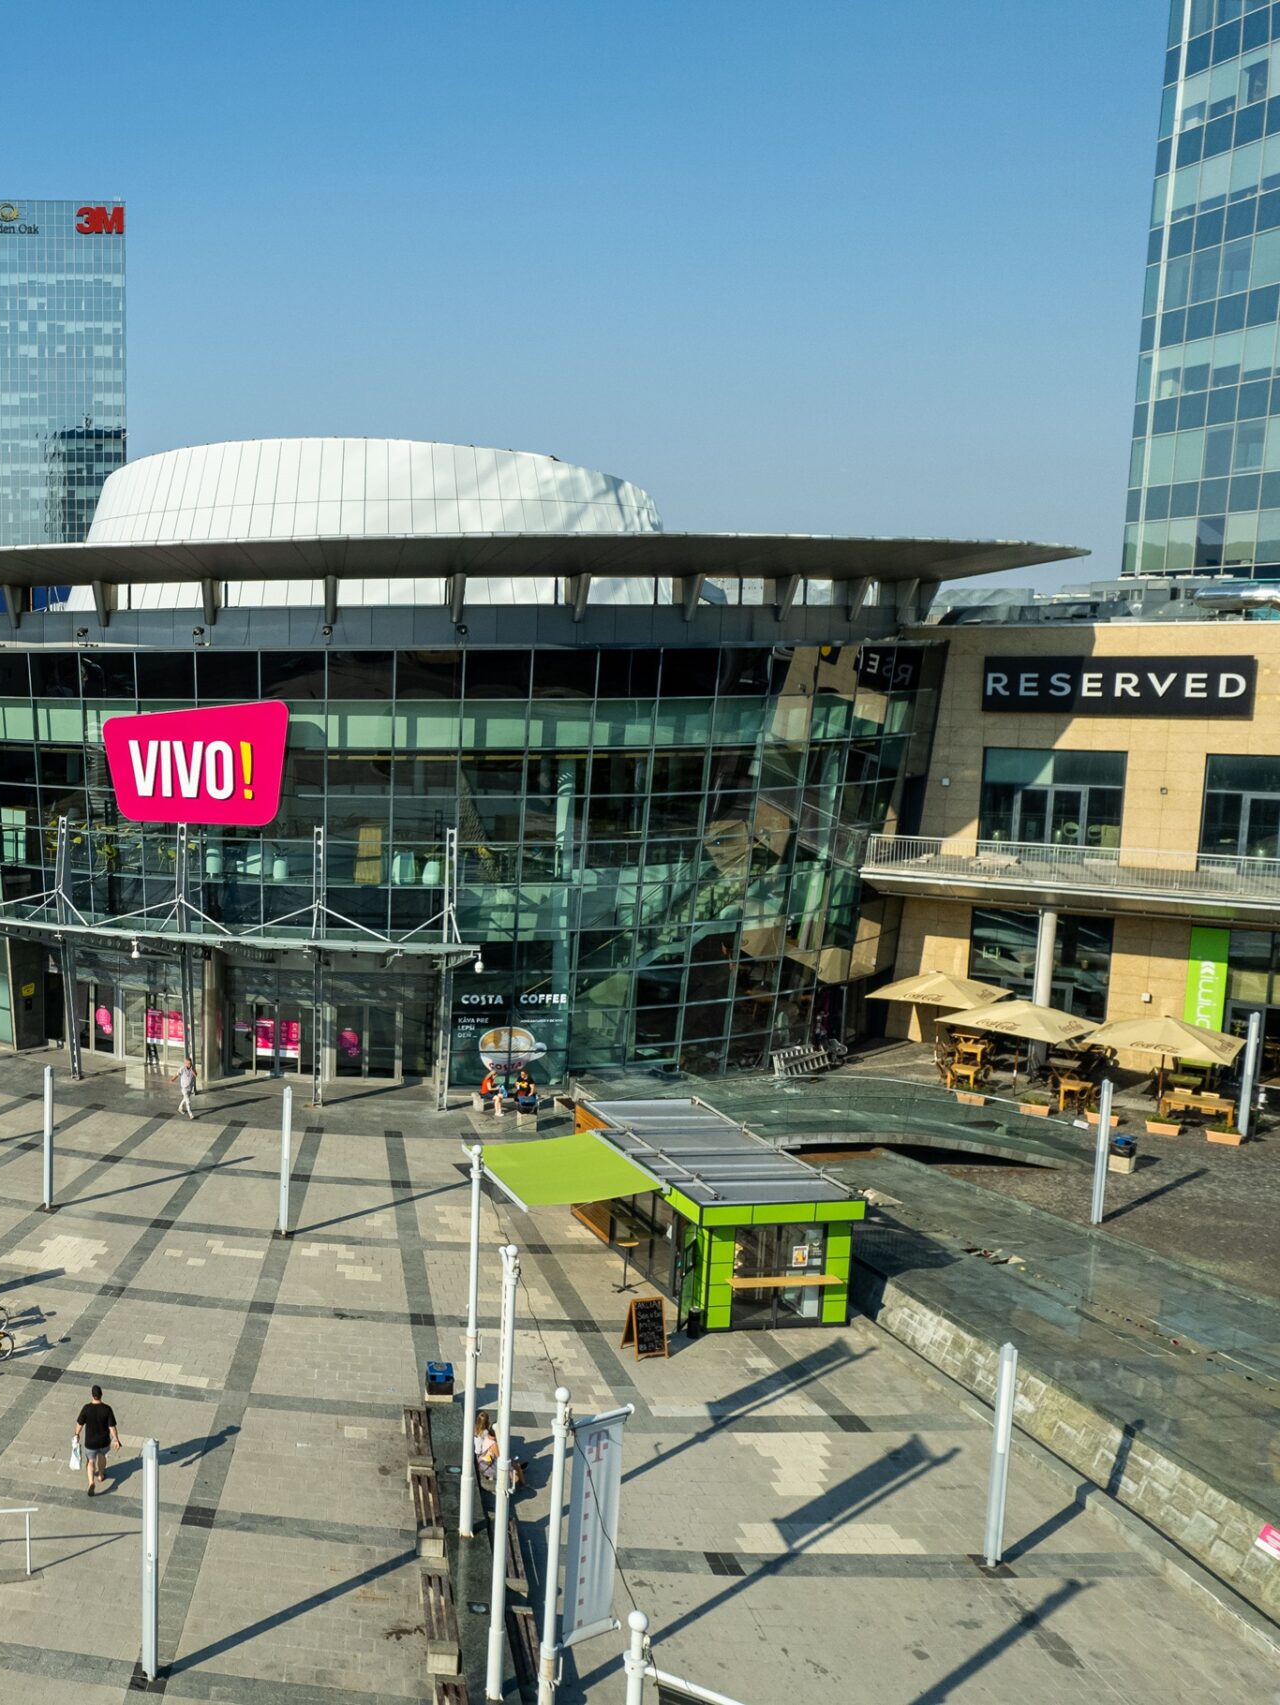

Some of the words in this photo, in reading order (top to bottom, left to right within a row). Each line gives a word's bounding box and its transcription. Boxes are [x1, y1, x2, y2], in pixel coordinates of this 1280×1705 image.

[75, 206, 125, 234] 3M
[18, 223, 39, 234] Oak
[986, 672, 1247, 698] RESERVED
[128, 740, 254, 800] VIVO!
[461, 994, 504, 1005] COSTA
[519, 993, 567, 1004] COFFEE
[903, 991, 944, 1002] Coca-Cola
[975, 1018, 1020, 1031] Coca-Cola
[1129, 1040, 1180, 1054] Coca-Cola
